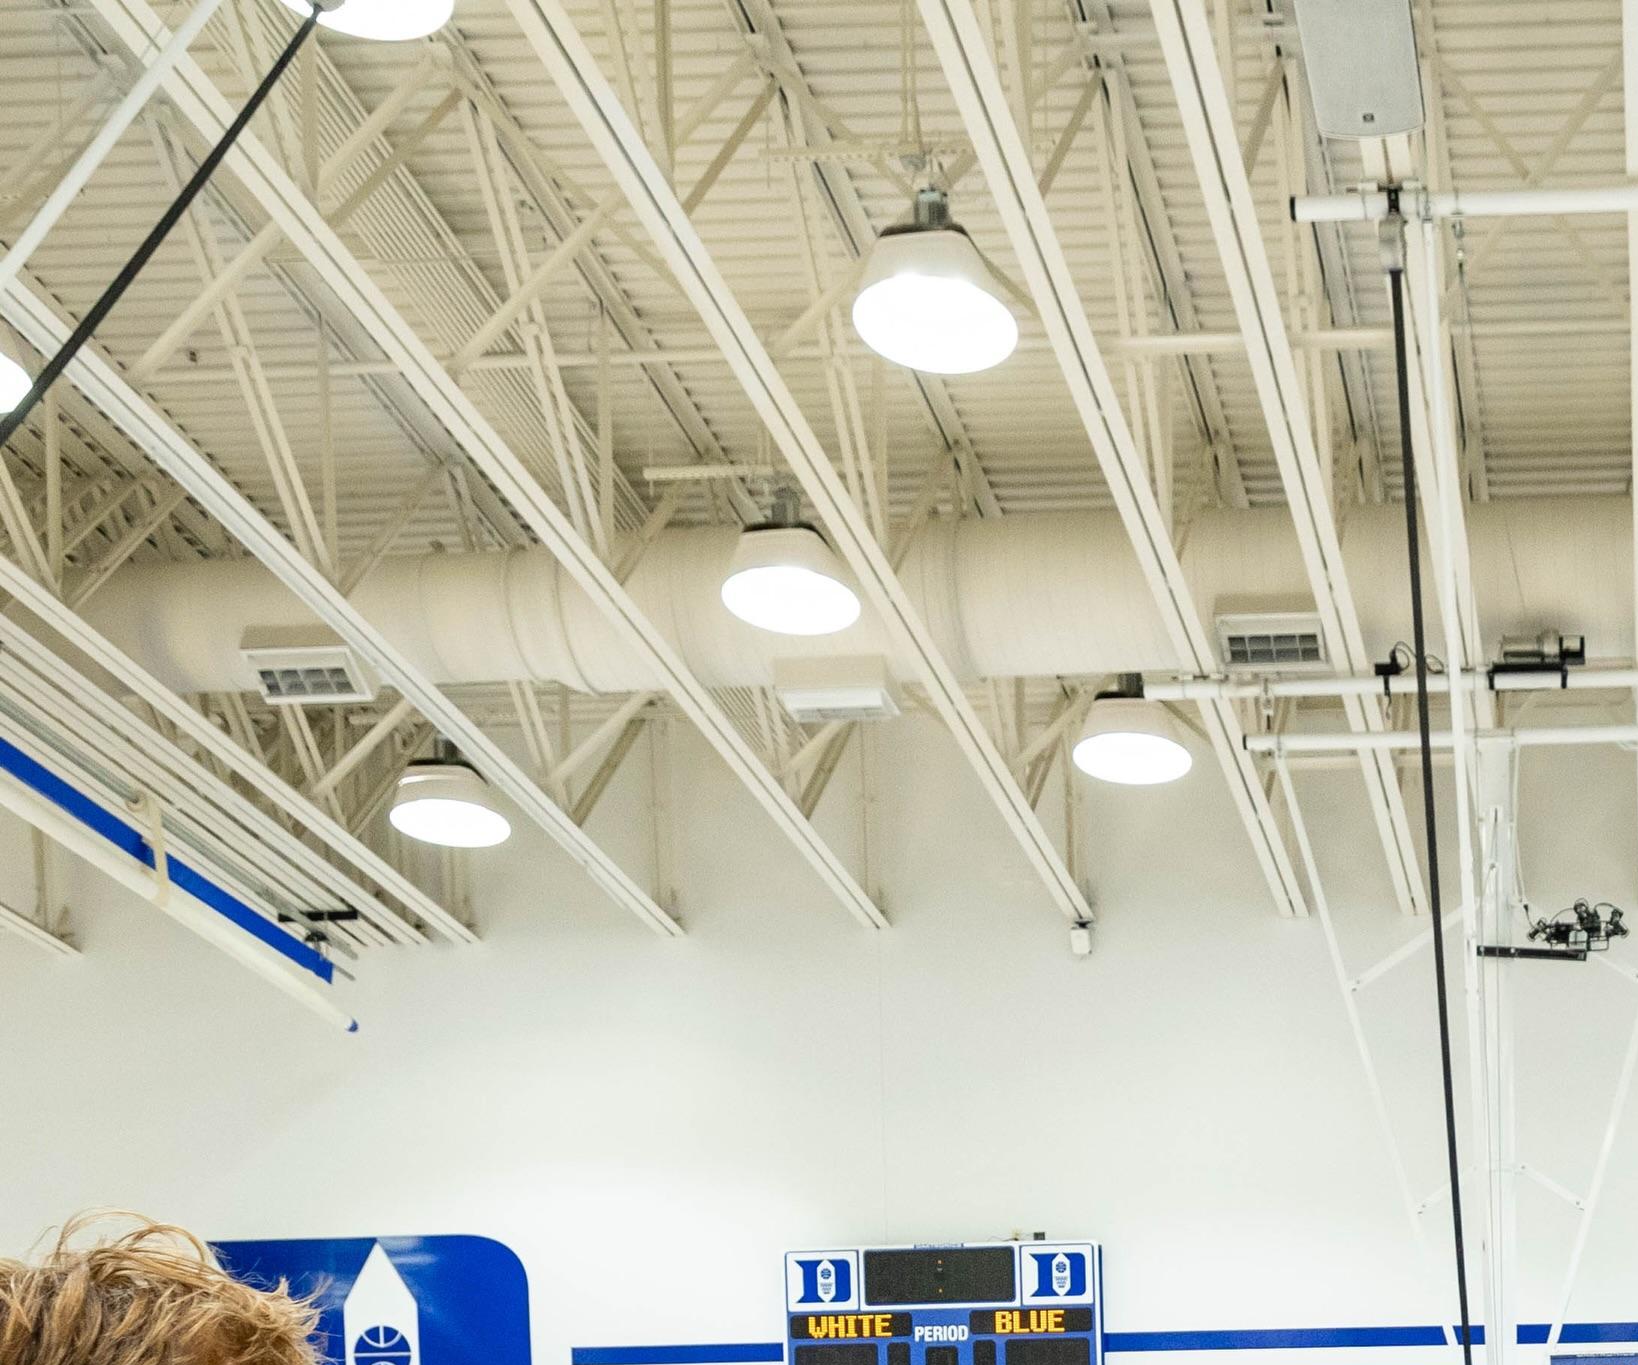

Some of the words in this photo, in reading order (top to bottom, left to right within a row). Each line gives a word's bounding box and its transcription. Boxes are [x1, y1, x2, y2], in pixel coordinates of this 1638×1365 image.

[808, 1313, 893, 1338] WHITE
[914, 1325, 969, 1343] PERIOD
[994, 1309, 1066, 1334] BLUE
